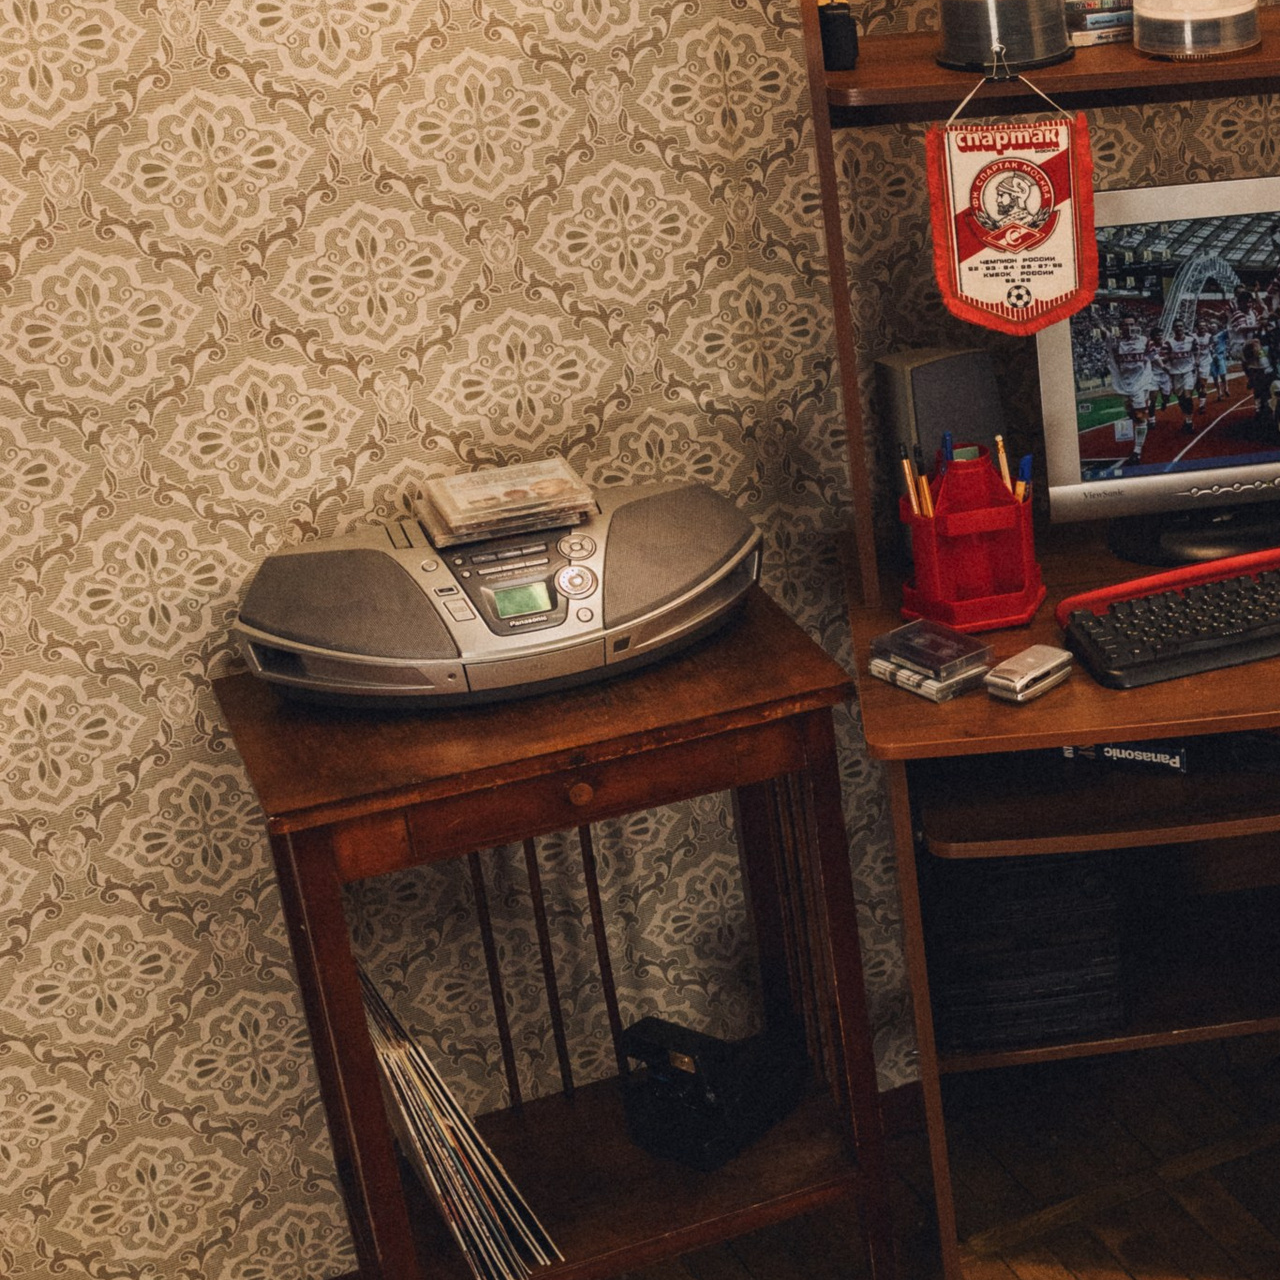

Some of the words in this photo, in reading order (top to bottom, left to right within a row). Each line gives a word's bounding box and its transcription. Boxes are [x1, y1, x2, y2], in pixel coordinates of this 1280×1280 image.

[972, 191, 979, 207] ФК
[976, 162, 1018, 186] СПАРТАК
[1022, 165, 1051, 198] МОСКВА
[1083, 489, 1124, 499] ViewSonic
[509, 616, 548, 627] Panasonic
[1103, 747, 1180, 768] Panasonic
